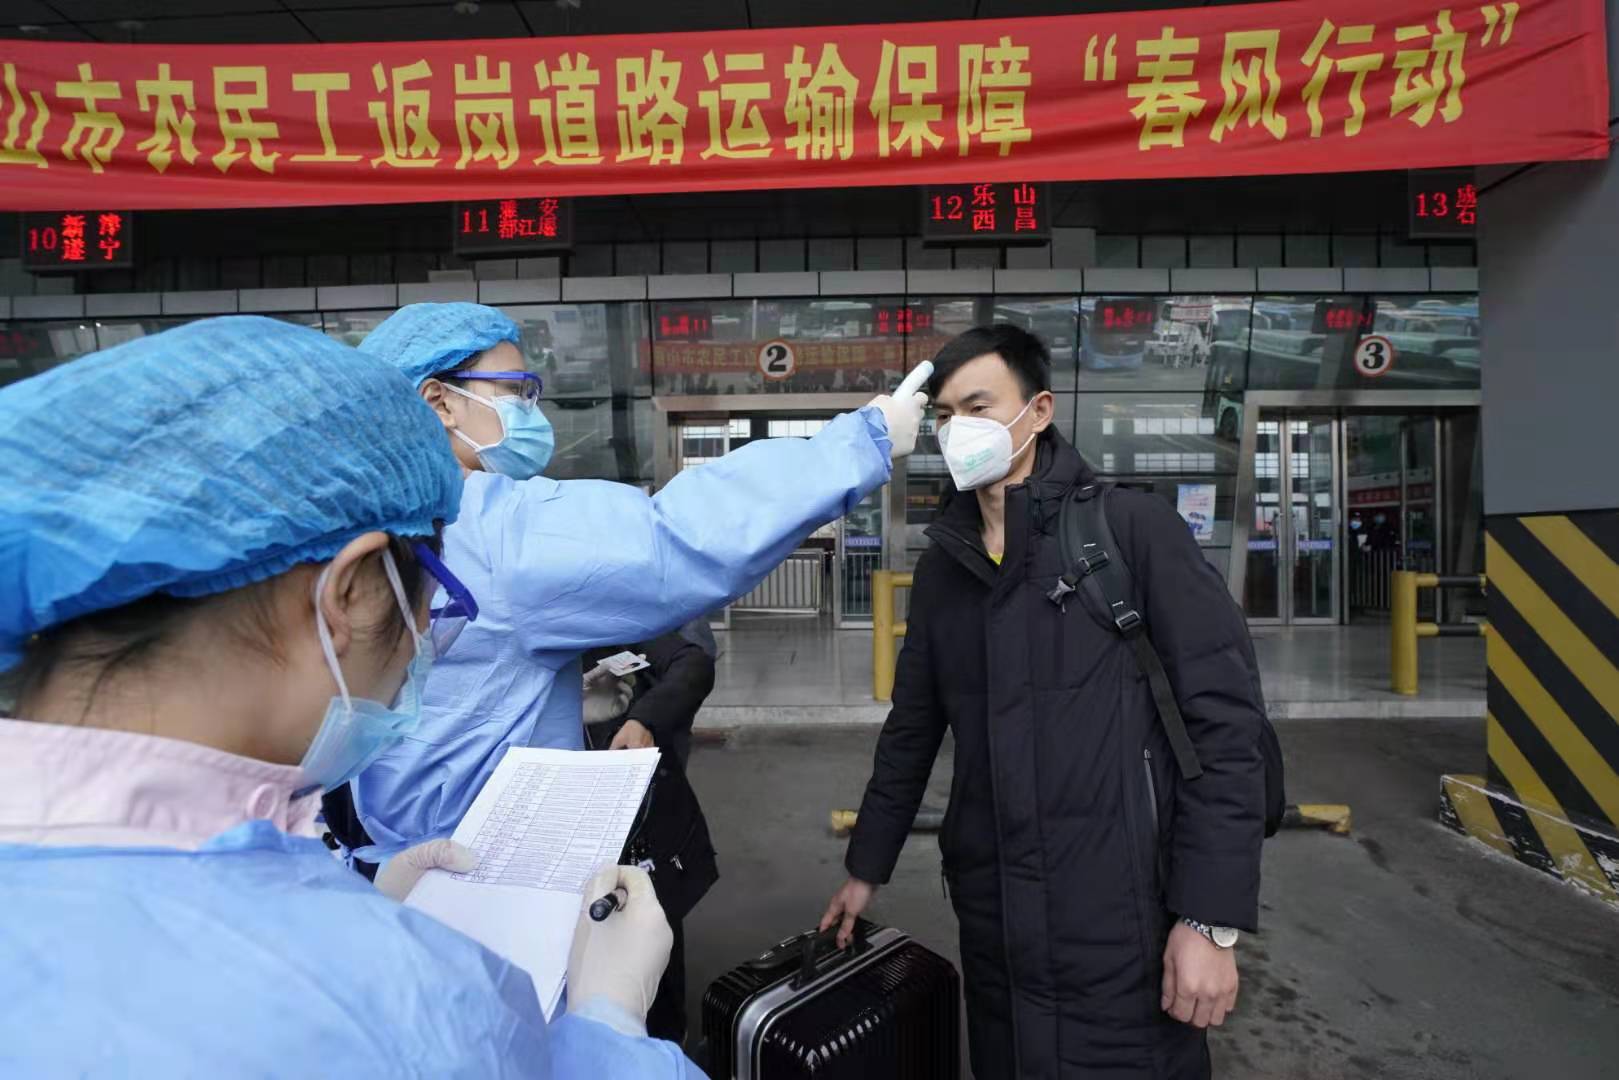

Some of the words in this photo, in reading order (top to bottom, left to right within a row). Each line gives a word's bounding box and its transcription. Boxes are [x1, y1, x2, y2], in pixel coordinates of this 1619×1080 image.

[972, 183, 1036, 206] 乐山
[1416, 192, 1448, 217] 13
[930, 195, 963, 220] 12
[972, 207, 1036, 231] 西昌
[463, 209, 490, 233] 11
[31, 227, 57, 251] 10
[766, 345, 788, 373] 2
[1362, 342, 1385, 370] 3
